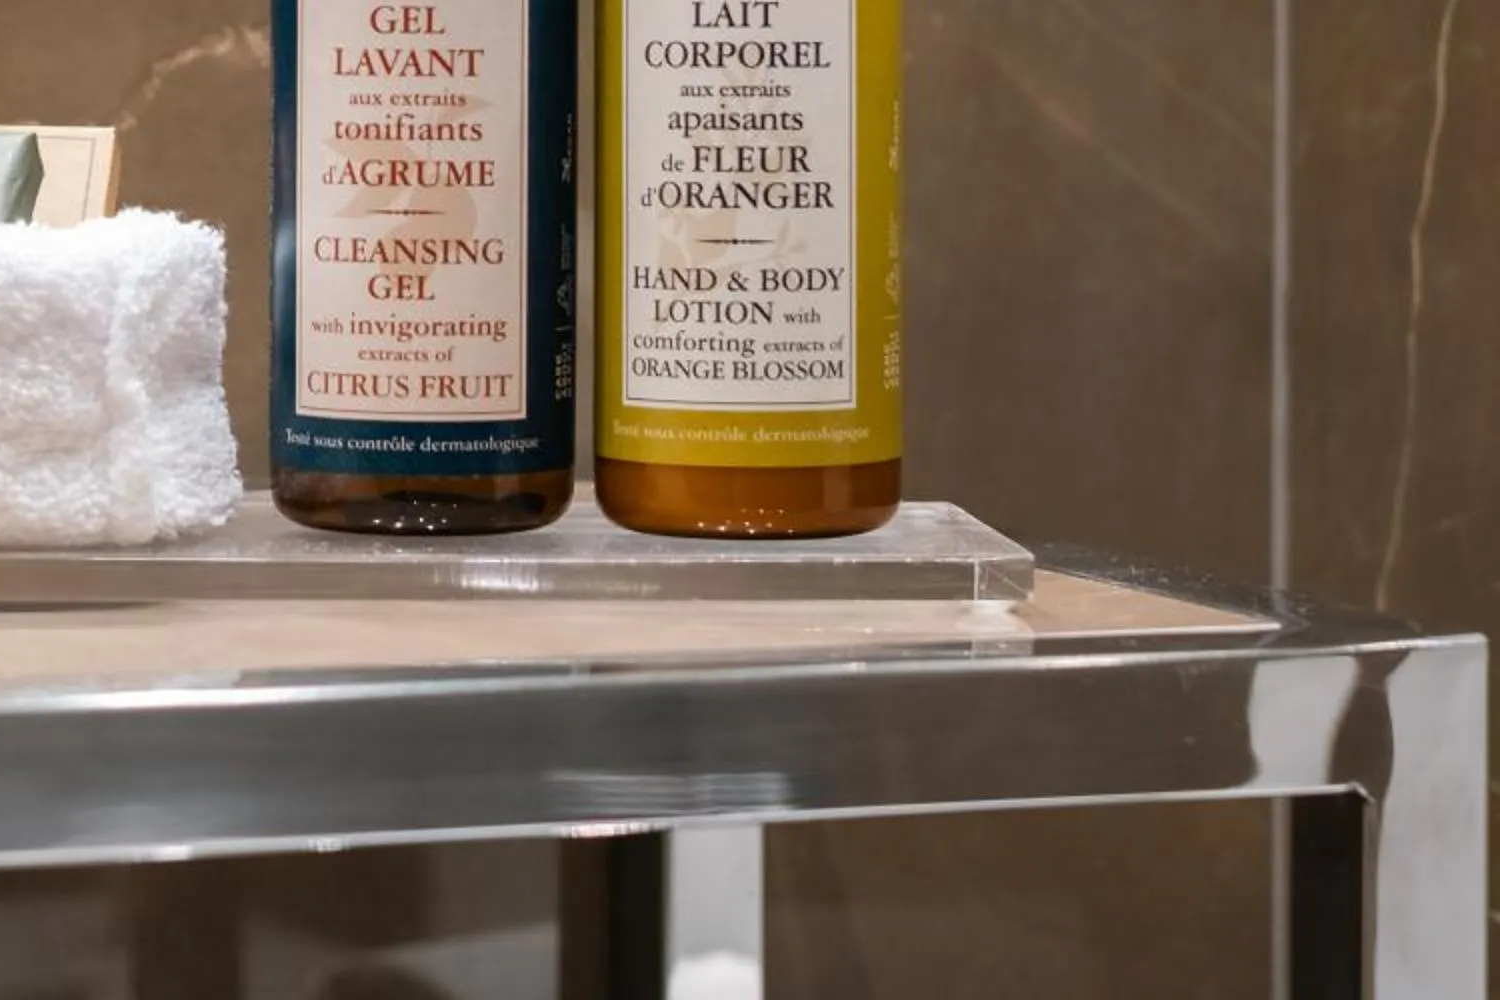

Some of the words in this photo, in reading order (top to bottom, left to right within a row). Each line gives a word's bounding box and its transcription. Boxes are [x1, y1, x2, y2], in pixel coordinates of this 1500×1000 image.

[369, 5, 445, 35] GEL
[691, 1, 779, 28] LAIT
[333, 47, 485, 78] LAVANT
[644, 40, 831, 69] CORPOREL
[349, 93, 383, 106] aux
[389, 88, 467, 107] extraits
[680, 84, 714, 97] aux
[719, 80, 791, 98] extraits
[334, 113, 483, 142] tonifiants
[667, 104, 804, 138] apaisants
[322, 158, 495, 187] d'AGRUME
[661, 153, 685, 172] de
[691, 145, 812, 173] FLEUR
[641, 181, 835, 209] d'ORANGER
[314, 235, 504, 265] CLEANSING
[368, 273, 436, 301] GEL
[632, 265, 717, 291] HAND
[727, 271, 749, 292] &
[760, 267, 845, 293] BODY
[653, 299, 774, 325] LOTION
[782, 307, 821, 324] with
[311, 317, 344, 334] with
[350, 312, 508, 342] invigorating
[357, 347, 429, 362] extracts
[434, 345, 455, 362] of
[633, 331, 756, 357] comforting
[763, 337, 825, 352] extracts
[829, 334, 845, 351] of
[631, 358, 725, 380] ORANGE
[732, 359, 844, 381] BLOSSOM
[307, 369, 410, 398] CITRUS
[419, 373, 513, 399] FRUIT
[313, 434, 343, 449] sous
[347, 435, 414, 452] contrôle
[419, 434, 540, 455] dermatologique
